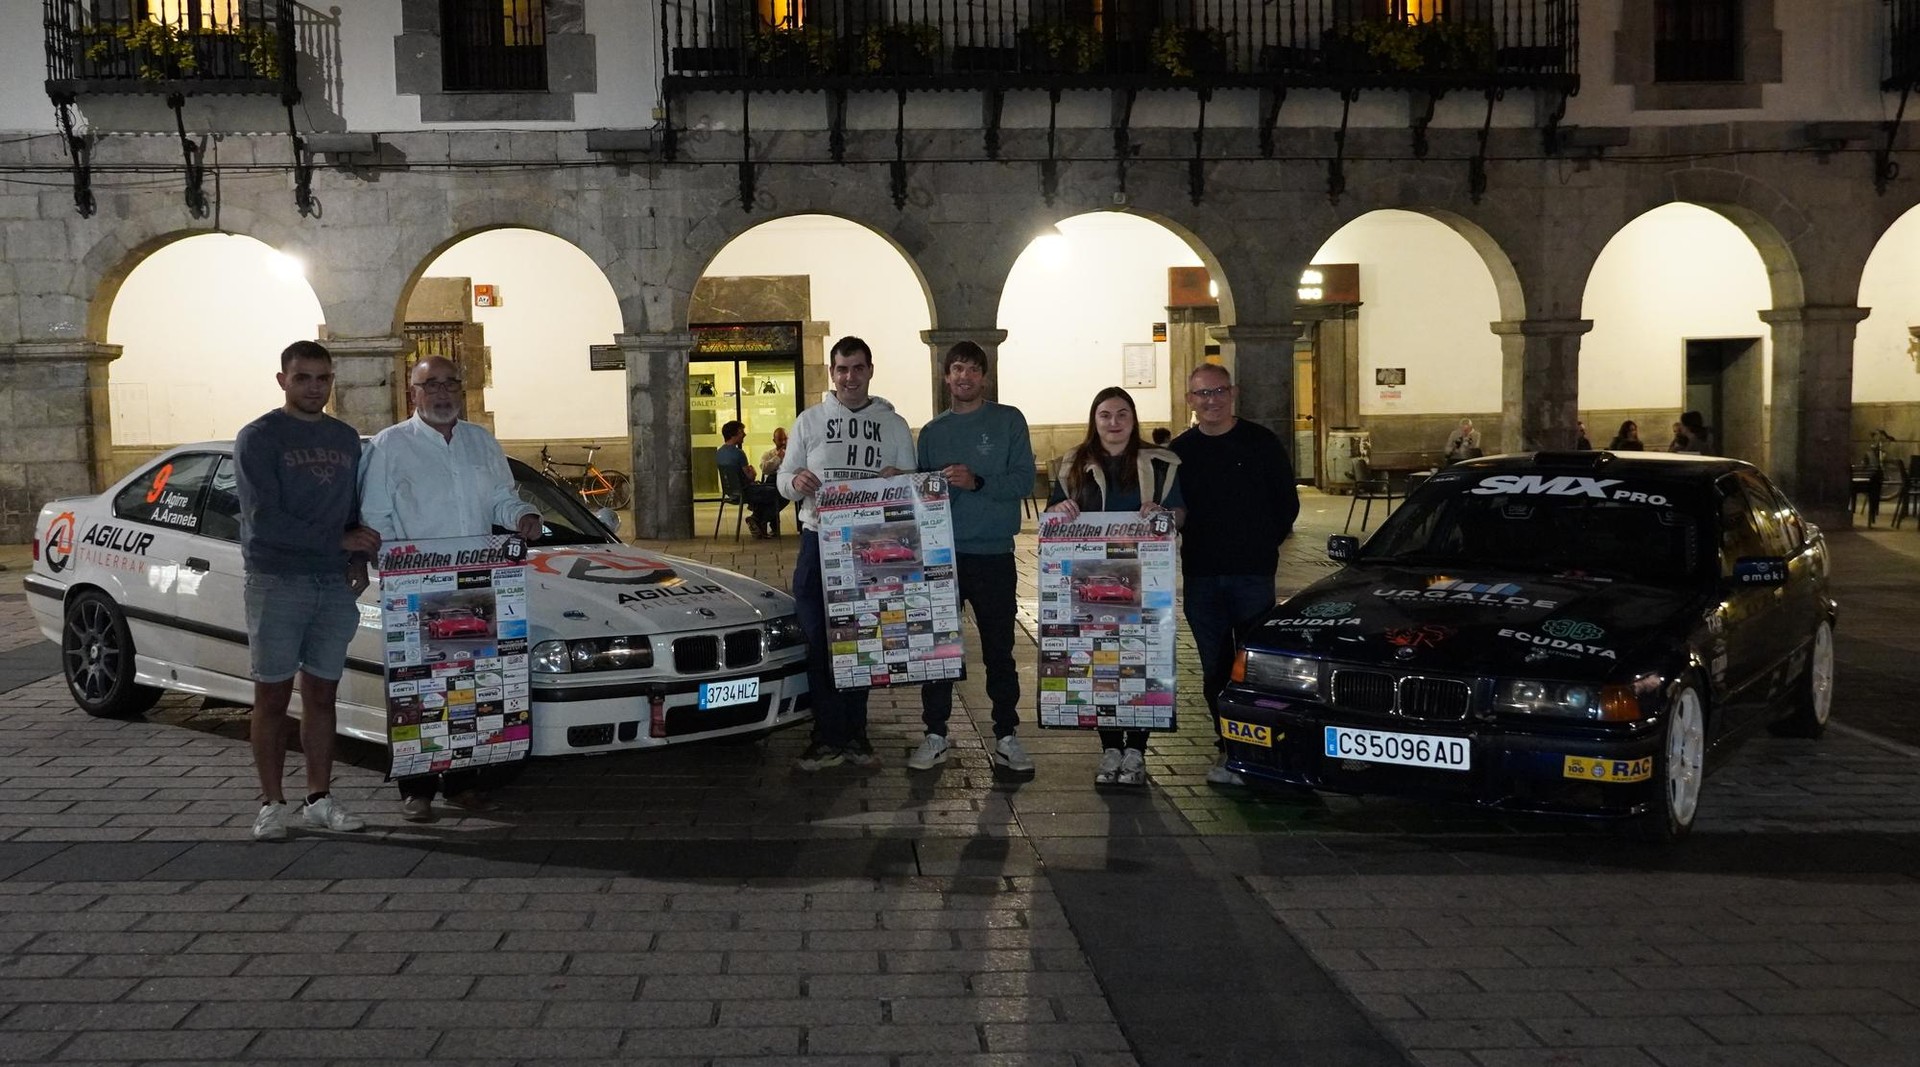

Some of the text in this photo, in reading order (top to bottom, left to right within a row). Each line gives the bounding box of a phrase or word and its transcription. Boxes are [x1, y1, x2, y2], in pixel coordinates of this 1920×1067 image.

[284, 448, 352, 468] SILBON
[146, 463, 174, 503] 9
[928, 481, 940, 492] 19
[1470, 475, 1624, 498] SMX
[165, 492, 188, 508] Agirre
[1154, 521, 1168, 533] 19
[82, 523, 155, 556] AGILUR
[79, 547, 145, 574] TAILERRAK
[507, 544, 521, 557] 19
[1742, 571, 1784, 582] emeki
[618, 585, 727, 605] AGILUR
[1372, 588, 1560, 610] URGALDE
[1263, 617, 1362, 627] ECUDATA
[1496, 628, 1617, 660] ECUDATA
[1228, 721, 1267, 741] RAC
[1568, 765, 1584, 773] 100
[1612, 759, 1650, 776] RAC
